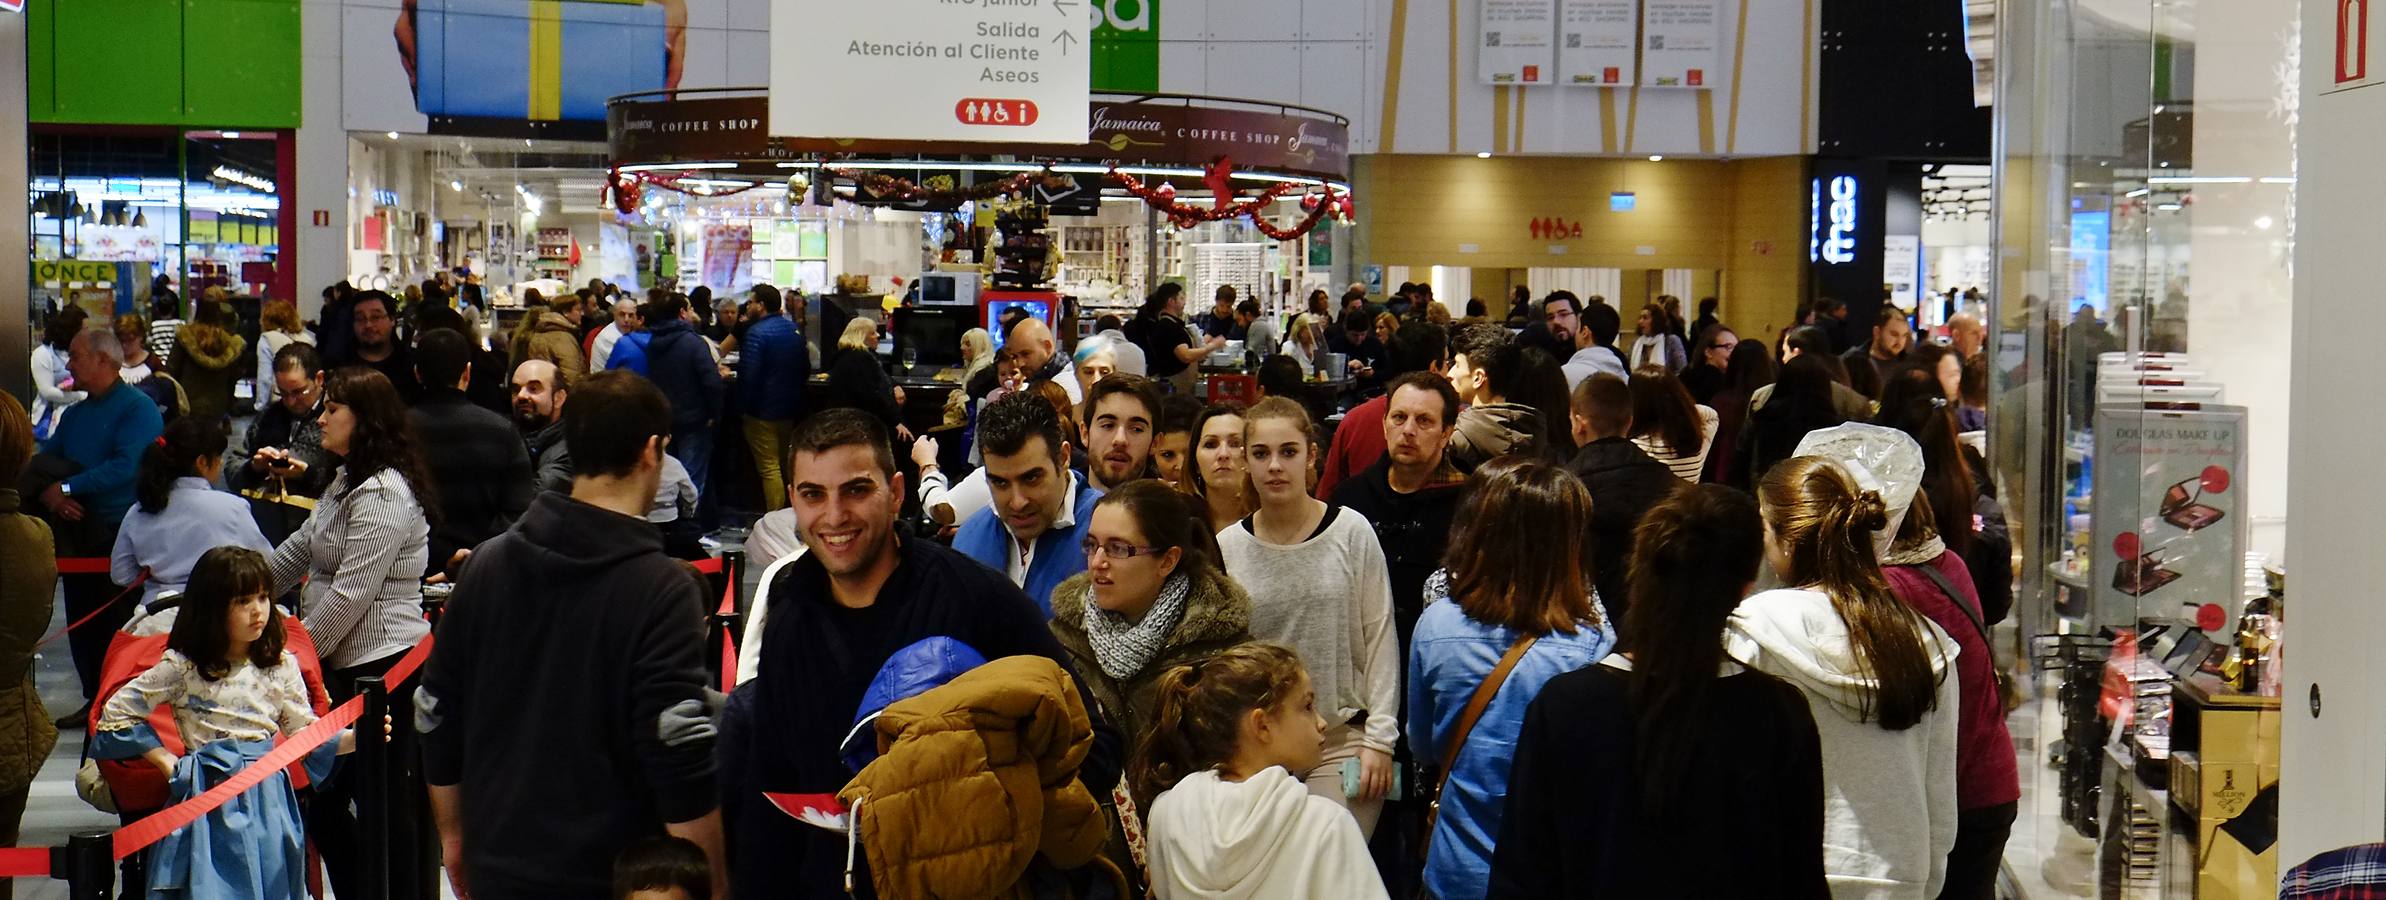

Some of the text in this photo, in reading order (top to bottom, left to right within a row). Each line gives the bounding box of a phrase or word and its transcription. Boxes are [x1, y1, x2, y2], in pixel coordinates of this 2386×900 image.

[976, 21, 1040, 38] Salida
[847, 40, 1040, 60] Atención al Cliente
[979, 67, 1039, 83] Aseos
[661, 120, 709, 132] COFFEE
[719, 118, 758, 130] SHOP
[1089, 107, 1161, 134] Jamaica
[1177, 128, 1237, 142] COFFEE
[1246, 132, 1280, 144] SHOP
[1822, 176, 1856, 264] fnac
[40, 263, 108, 281] ONCE
[2213, 430, 2230, 441] UP
